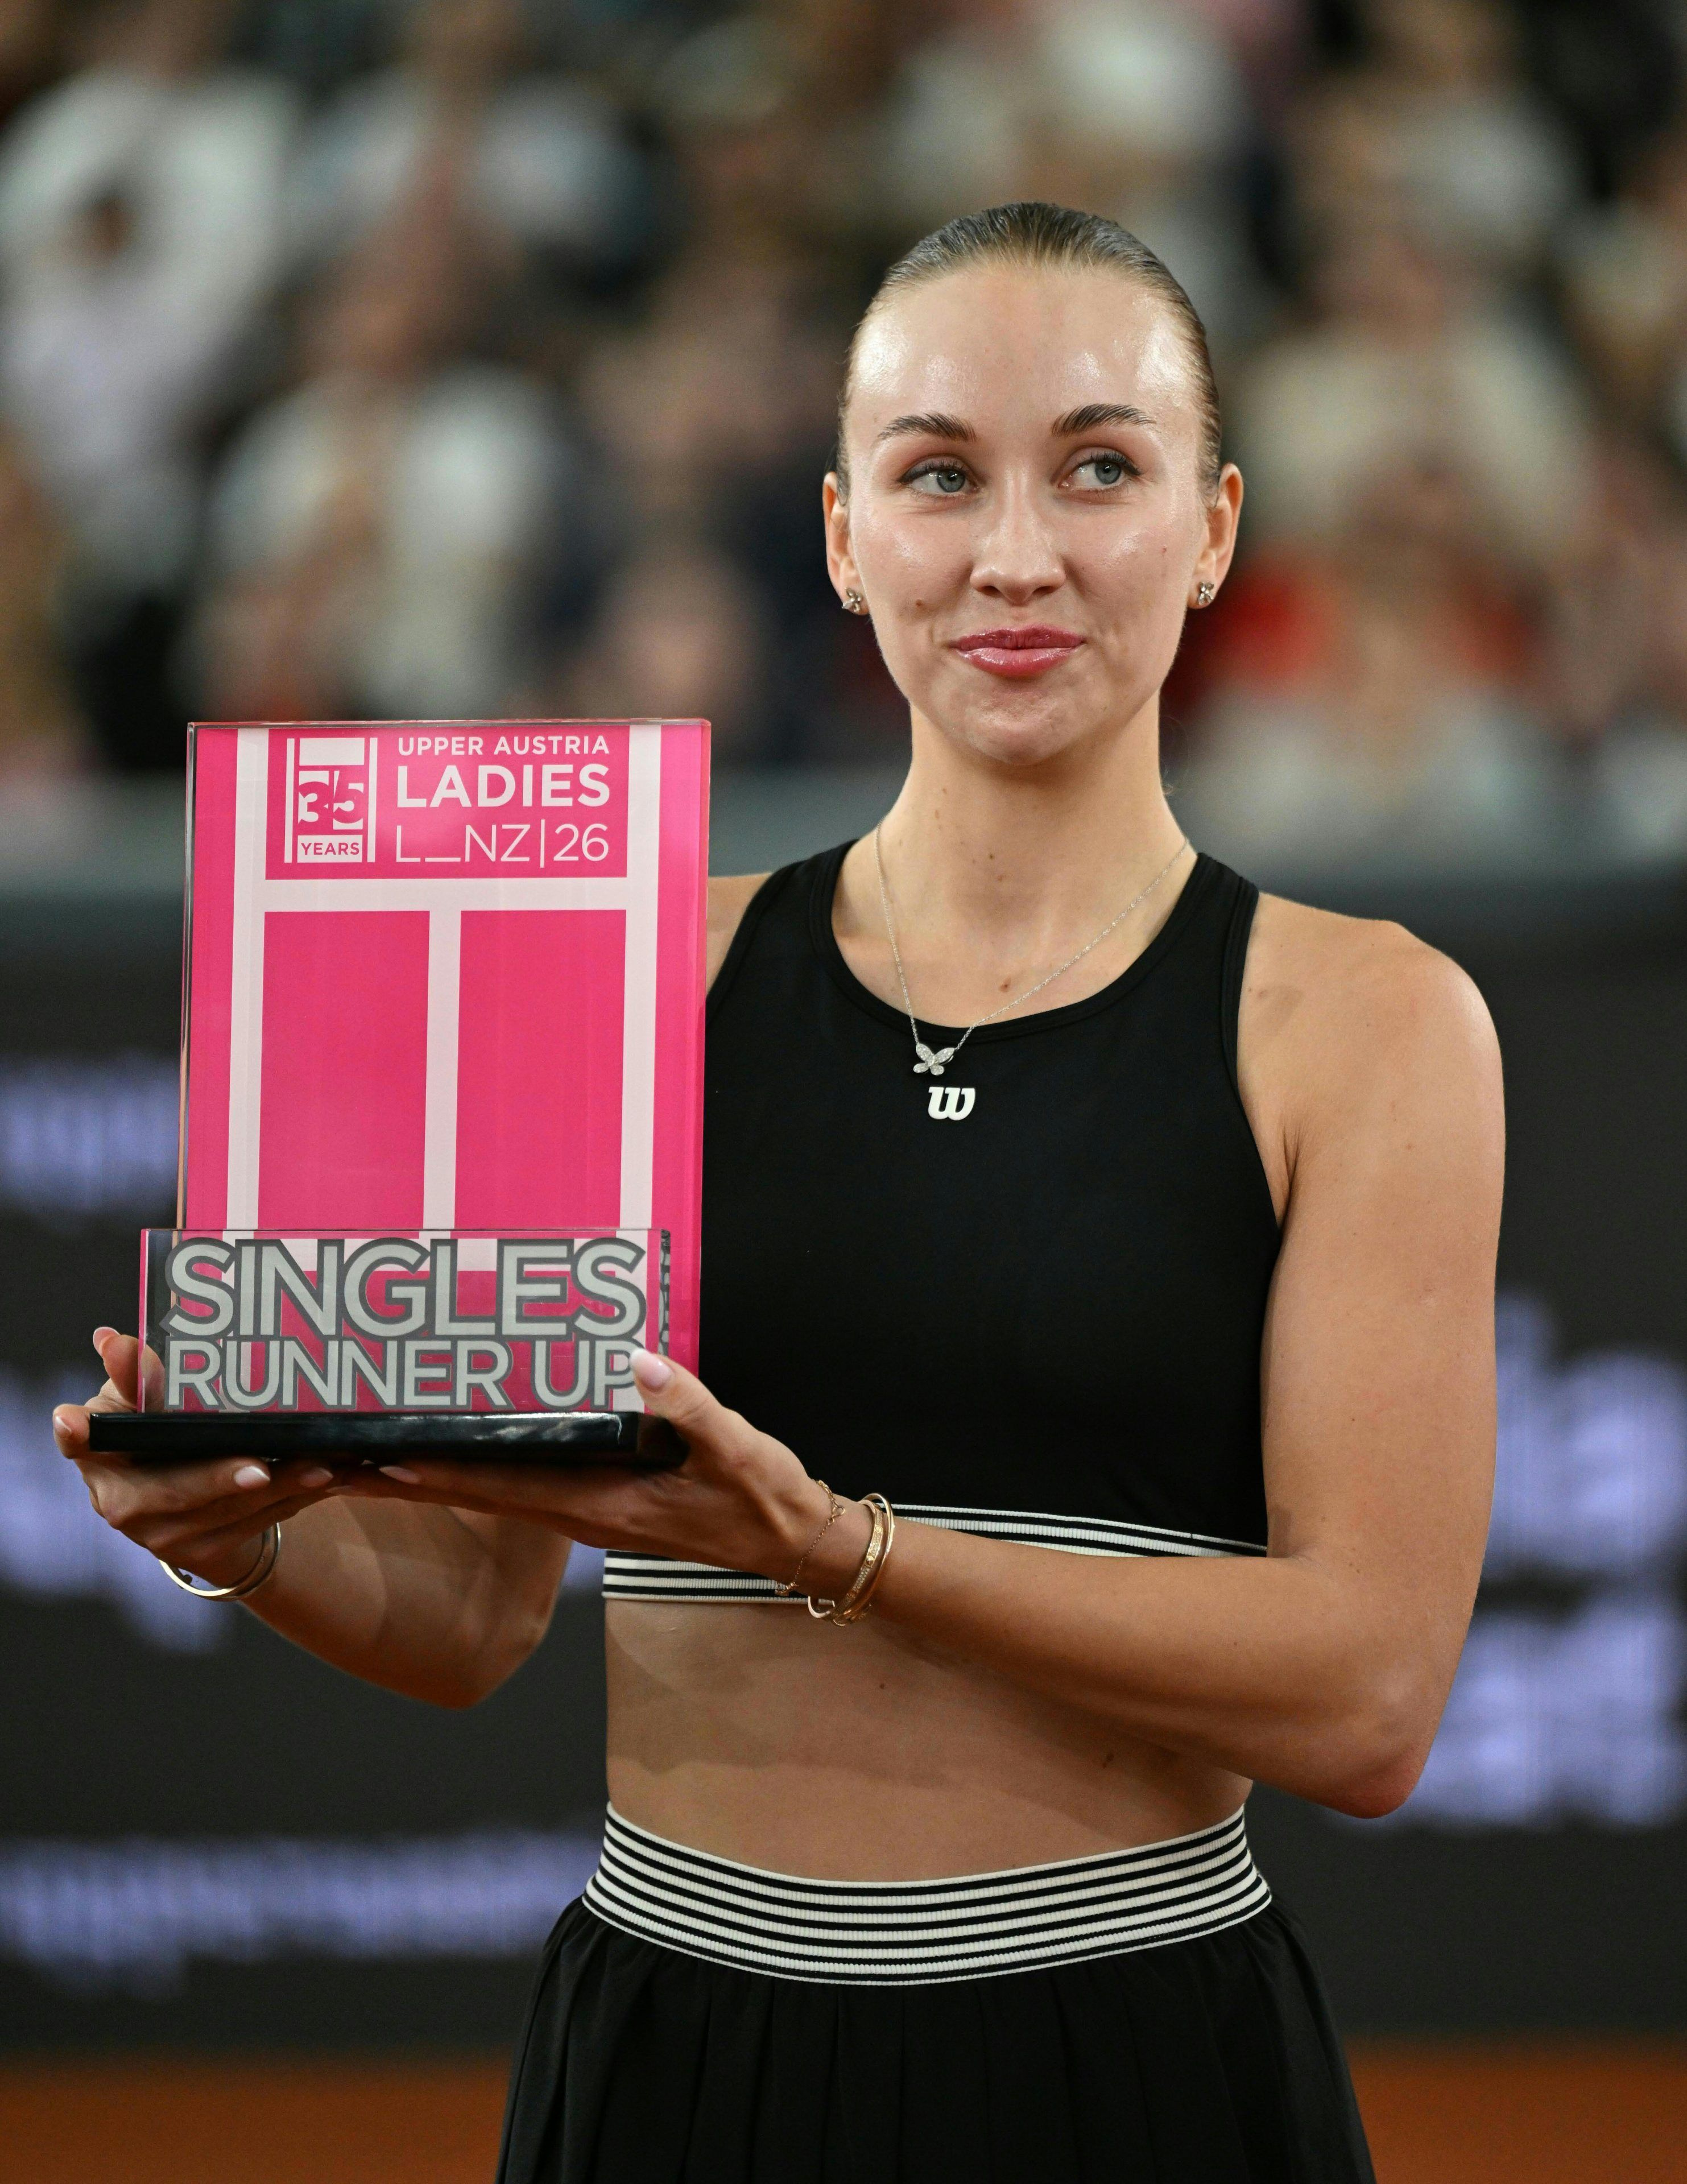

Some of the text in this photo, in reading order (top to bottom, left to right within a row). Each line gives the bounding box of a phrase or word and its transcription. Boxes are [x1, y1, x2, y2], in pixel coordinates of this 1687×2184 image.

[398, 735, 610, 755] UPPER AUSTRIA
[398, 763, 610, 808] LADIES
[300, 842, 360, 856] YEARS
[161, 1238, 646, 1338] SINGLES
[164, 1337, 645, 1410] RUNNER UP
